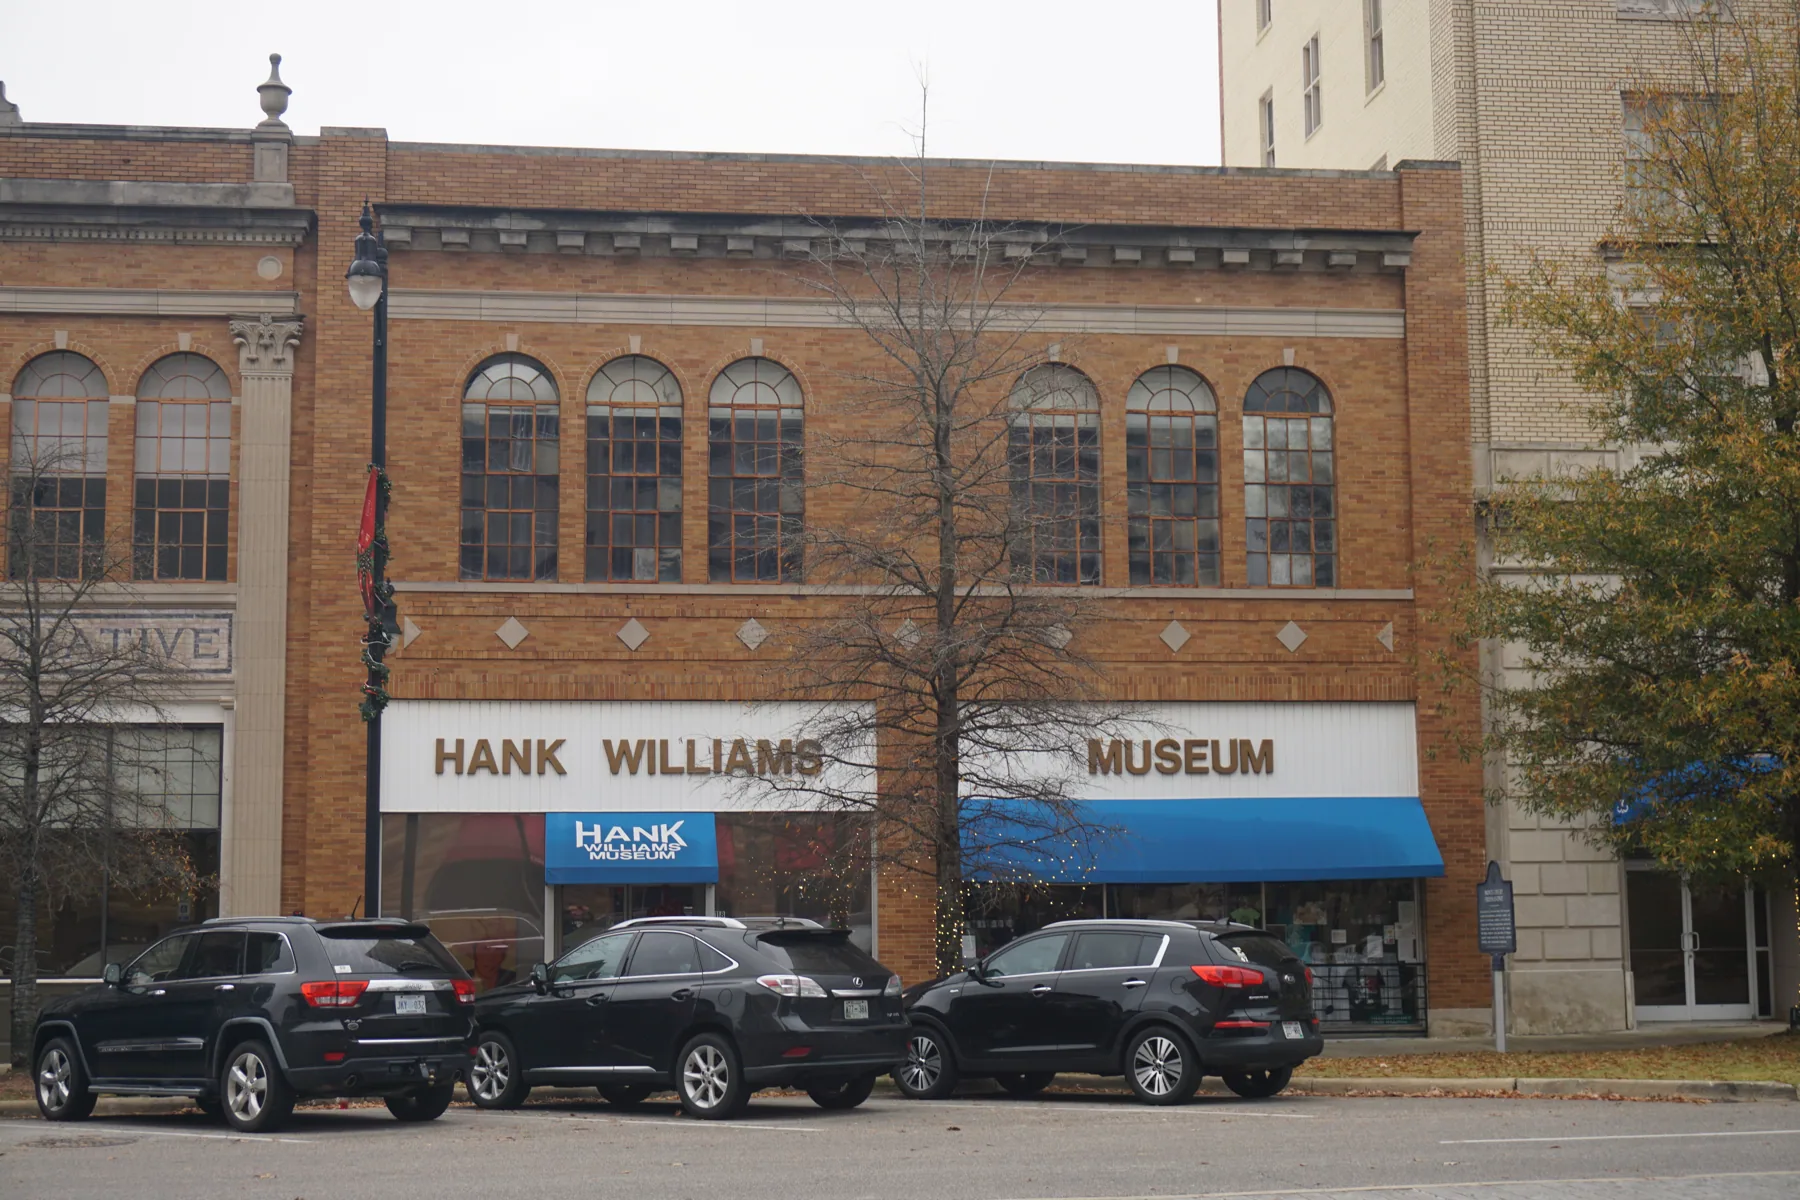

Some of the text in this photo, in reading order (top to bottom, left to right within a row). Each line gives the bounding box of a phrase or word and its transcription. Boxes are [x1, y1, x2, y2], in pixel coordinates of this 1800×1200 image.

[434, 738, 825, 776] HANK WILLIAMS
[1088, 738, 1274, 775] MUSEUM
[575, 819, 688, 849] HANK
[583, 842, 682, 852] WILLIAMS
[589, 851, 676, 860] MUSEUM
